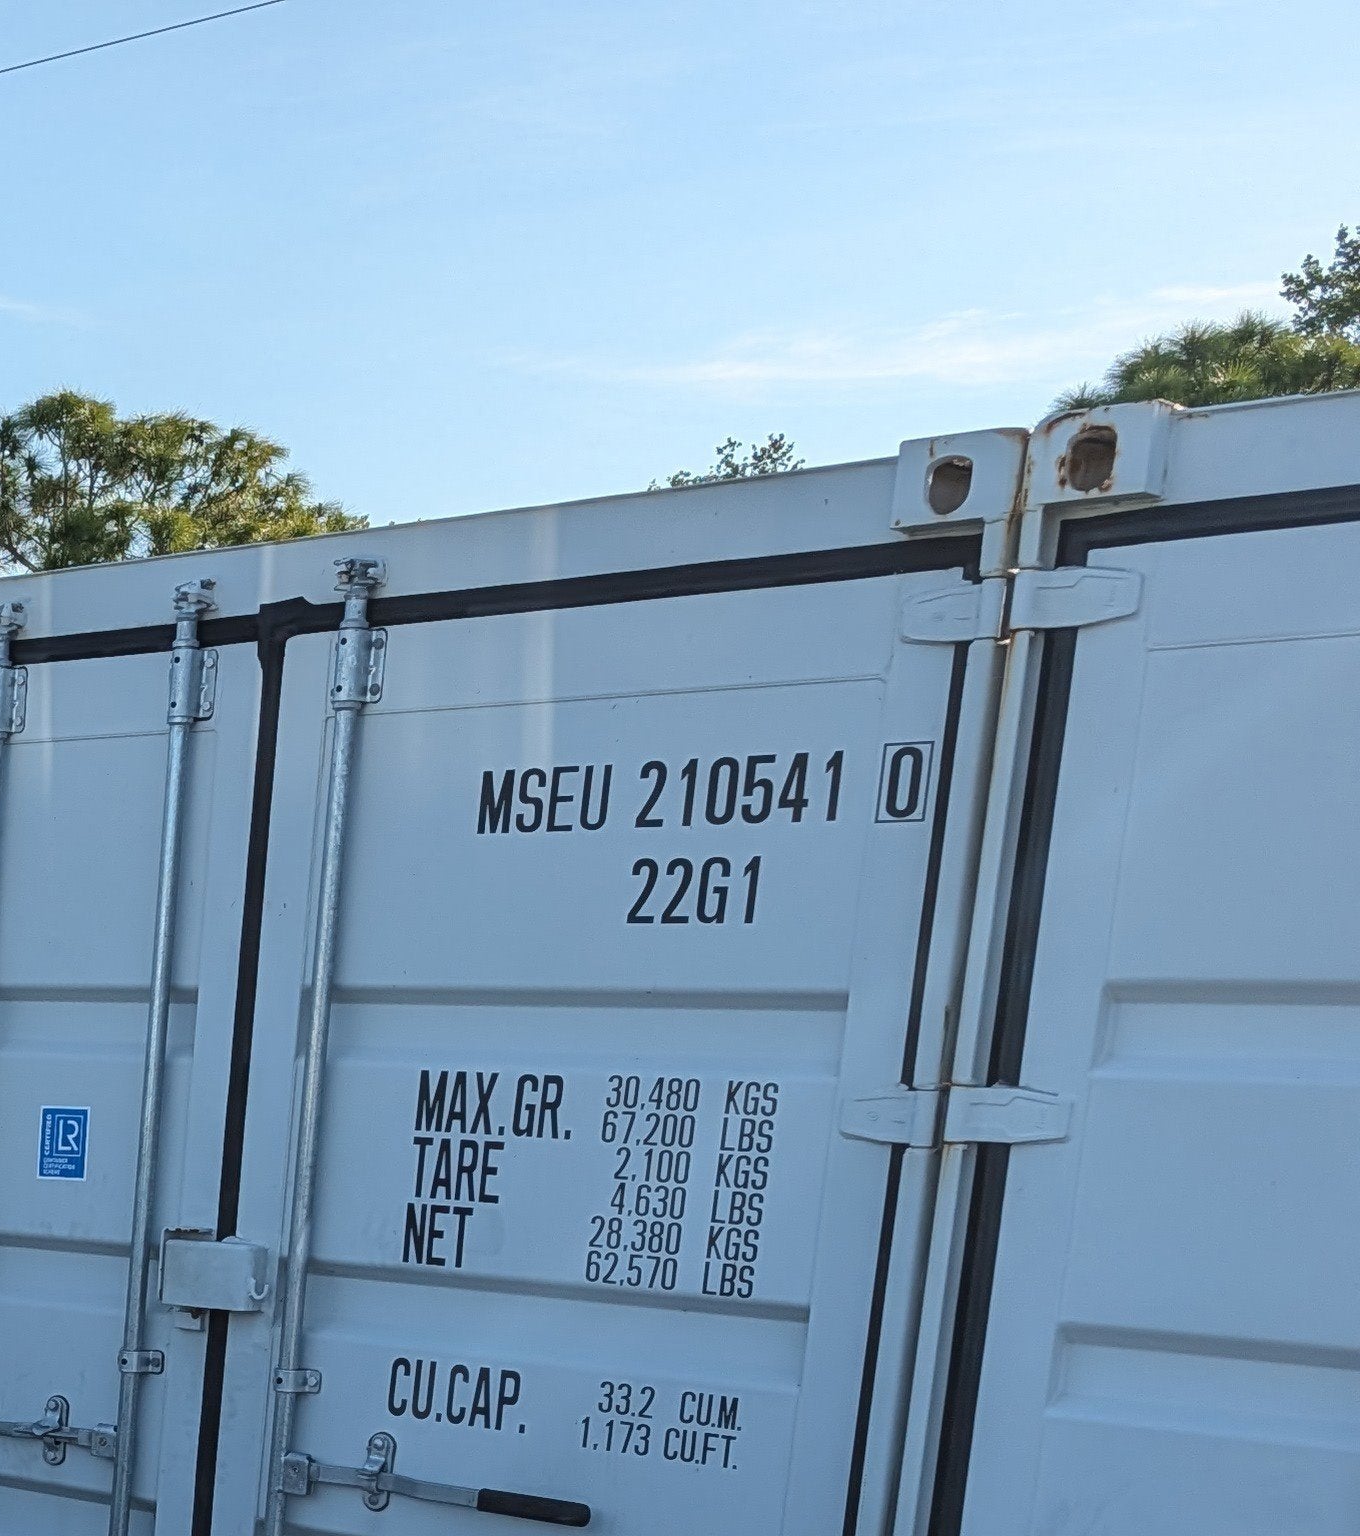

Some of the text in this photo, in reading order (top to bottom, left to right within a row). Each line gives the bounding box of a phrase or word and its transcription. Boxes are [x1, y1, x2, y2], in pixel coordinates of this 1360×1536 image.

[477, 747, 923, 834] MSEU 210541 0
[627, 856, 761, 924] 22G1
[58, 1119, 79, 1151] LR
[415, 1070, 778, 1139] MAX.GR. 30,480 KGS
[602, 1110, 773, 1153] 67,200 LBS
[413, 1137, 769, 1204] TARE 2,100 KGS
[403, 1203, 759, 1268] NET 28,380 KGS
[611, 1182, 763, 1226] 4,630 LBS
[586, 1251, 754, 1298] 62,570 LBS
[388, 1358, 741, 1433] CU.CAP. 33.2 CU.M.
[582, 1417, 738, 1469] 1,173 CU.FT.
